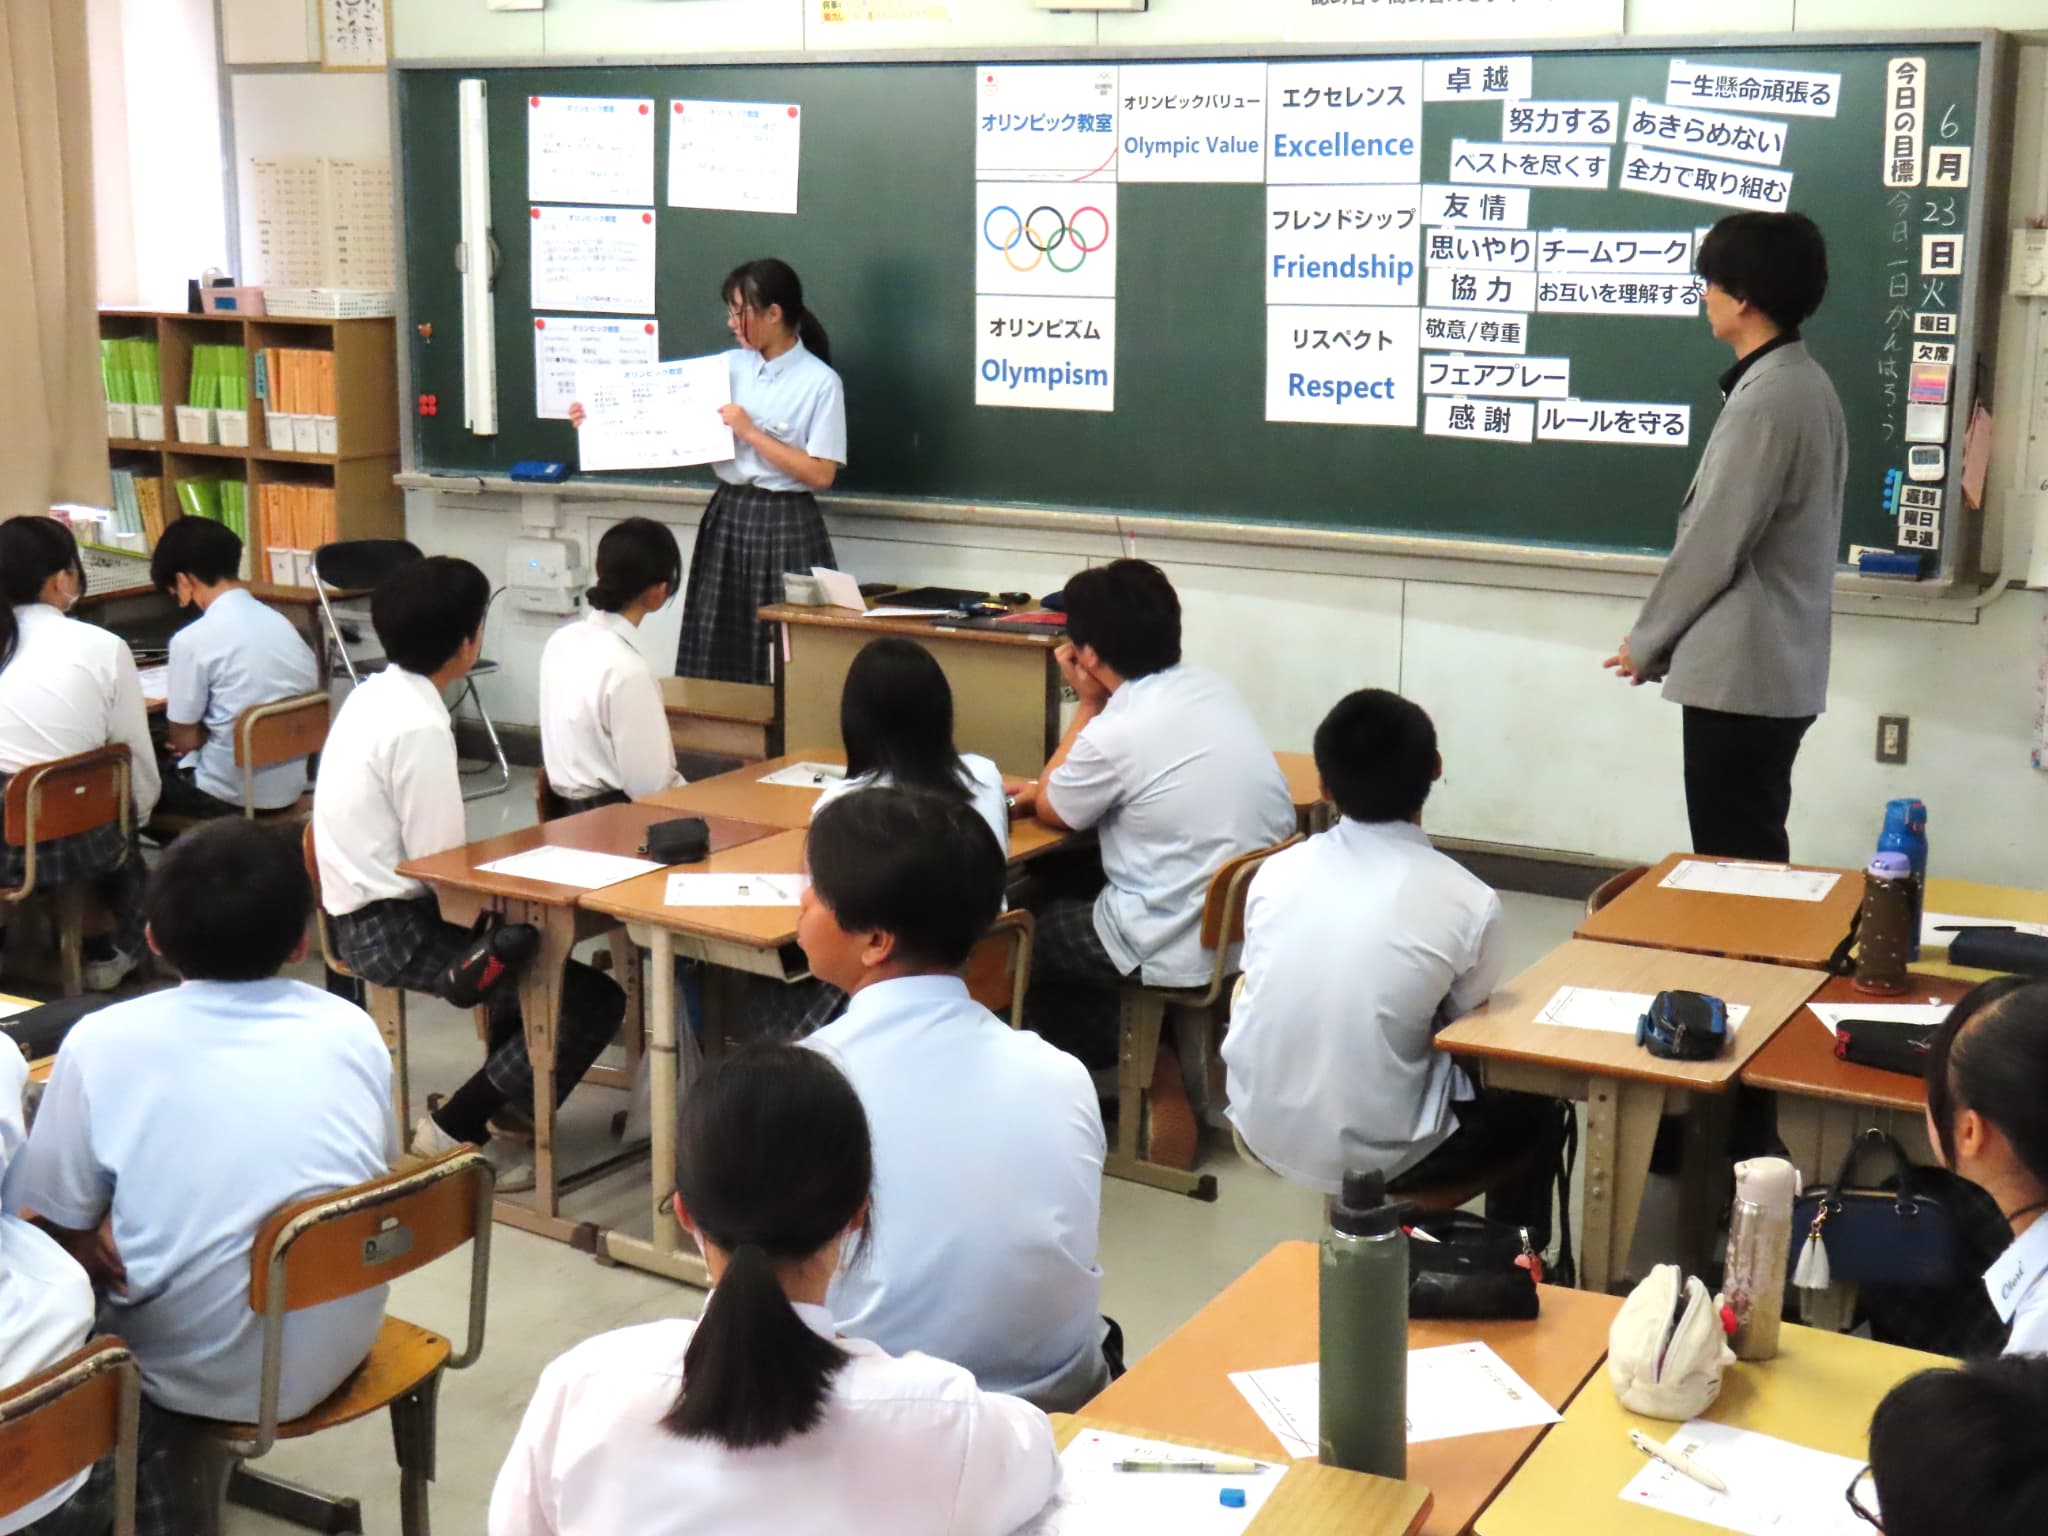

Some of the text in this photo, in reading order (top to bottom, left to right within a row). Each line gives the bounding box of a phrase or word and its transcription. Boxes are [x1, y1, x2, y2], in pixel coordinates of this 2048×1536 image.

[1447, 65, 1509, 93] 卓越
[1671, 75, 1831, 106] 一生懸命頑張る
[1124, 94, 1260, 111] オリンピックバリュー
[1283, 86, 1406, 109] エクセレンス
[982, 113, 1113, 133] オリンピック教室
[1509, 107, 1611, 135] 努力する
[1632, 110, 1781, 154] あきらめない
[1892, 61, 1918, 184] 今日の目標
[1940, 103, 1958, 139] 6
[1124, 135, 1259, 159] Olympic Value
[1274, 131, 1414, 158] Excellence
[1455, 152, 1607, 178] ベストを尽くす
[1936, 153, 1962, 182] 月
[1627, 157, 1787, 203] 全力で取り組む
[1272, 208, 1416, 230] フレンドシップ
[1443, 192, 1506, 220] 友情
[1922, 197, 1956, 226] 23
[1430, 235, 1530, 262] 思いやり
[1542, 239, 1687, 265] チームワーク
[1931, 242, 1955, 269] 日
[1273, 253, 1414, 285] Friendship
[1451, 273, 1512, 303] 協力
[1539, 280, 1699, 305] お互いを理解する
[1921, 278, 1945, 308] 火
[989, 318, 1101, 340] オリンピズム
[1425, 317, 1521, 344] 敬意/尊重
[1920, 316, 1950, 333] 曜日
[1293, 328, 1393, 351] リスペクト
[1918, 345, 1949, 362] 欠席
[982, 358, 1108, 390] Olympism
[1430, 363, 1566, 388] フェアプレー
[1288, 373, 1395, 405] Respect
[1449, 404, 1512, 434] 感謝
[1542, 408, 1685, 436] ルールを守る
